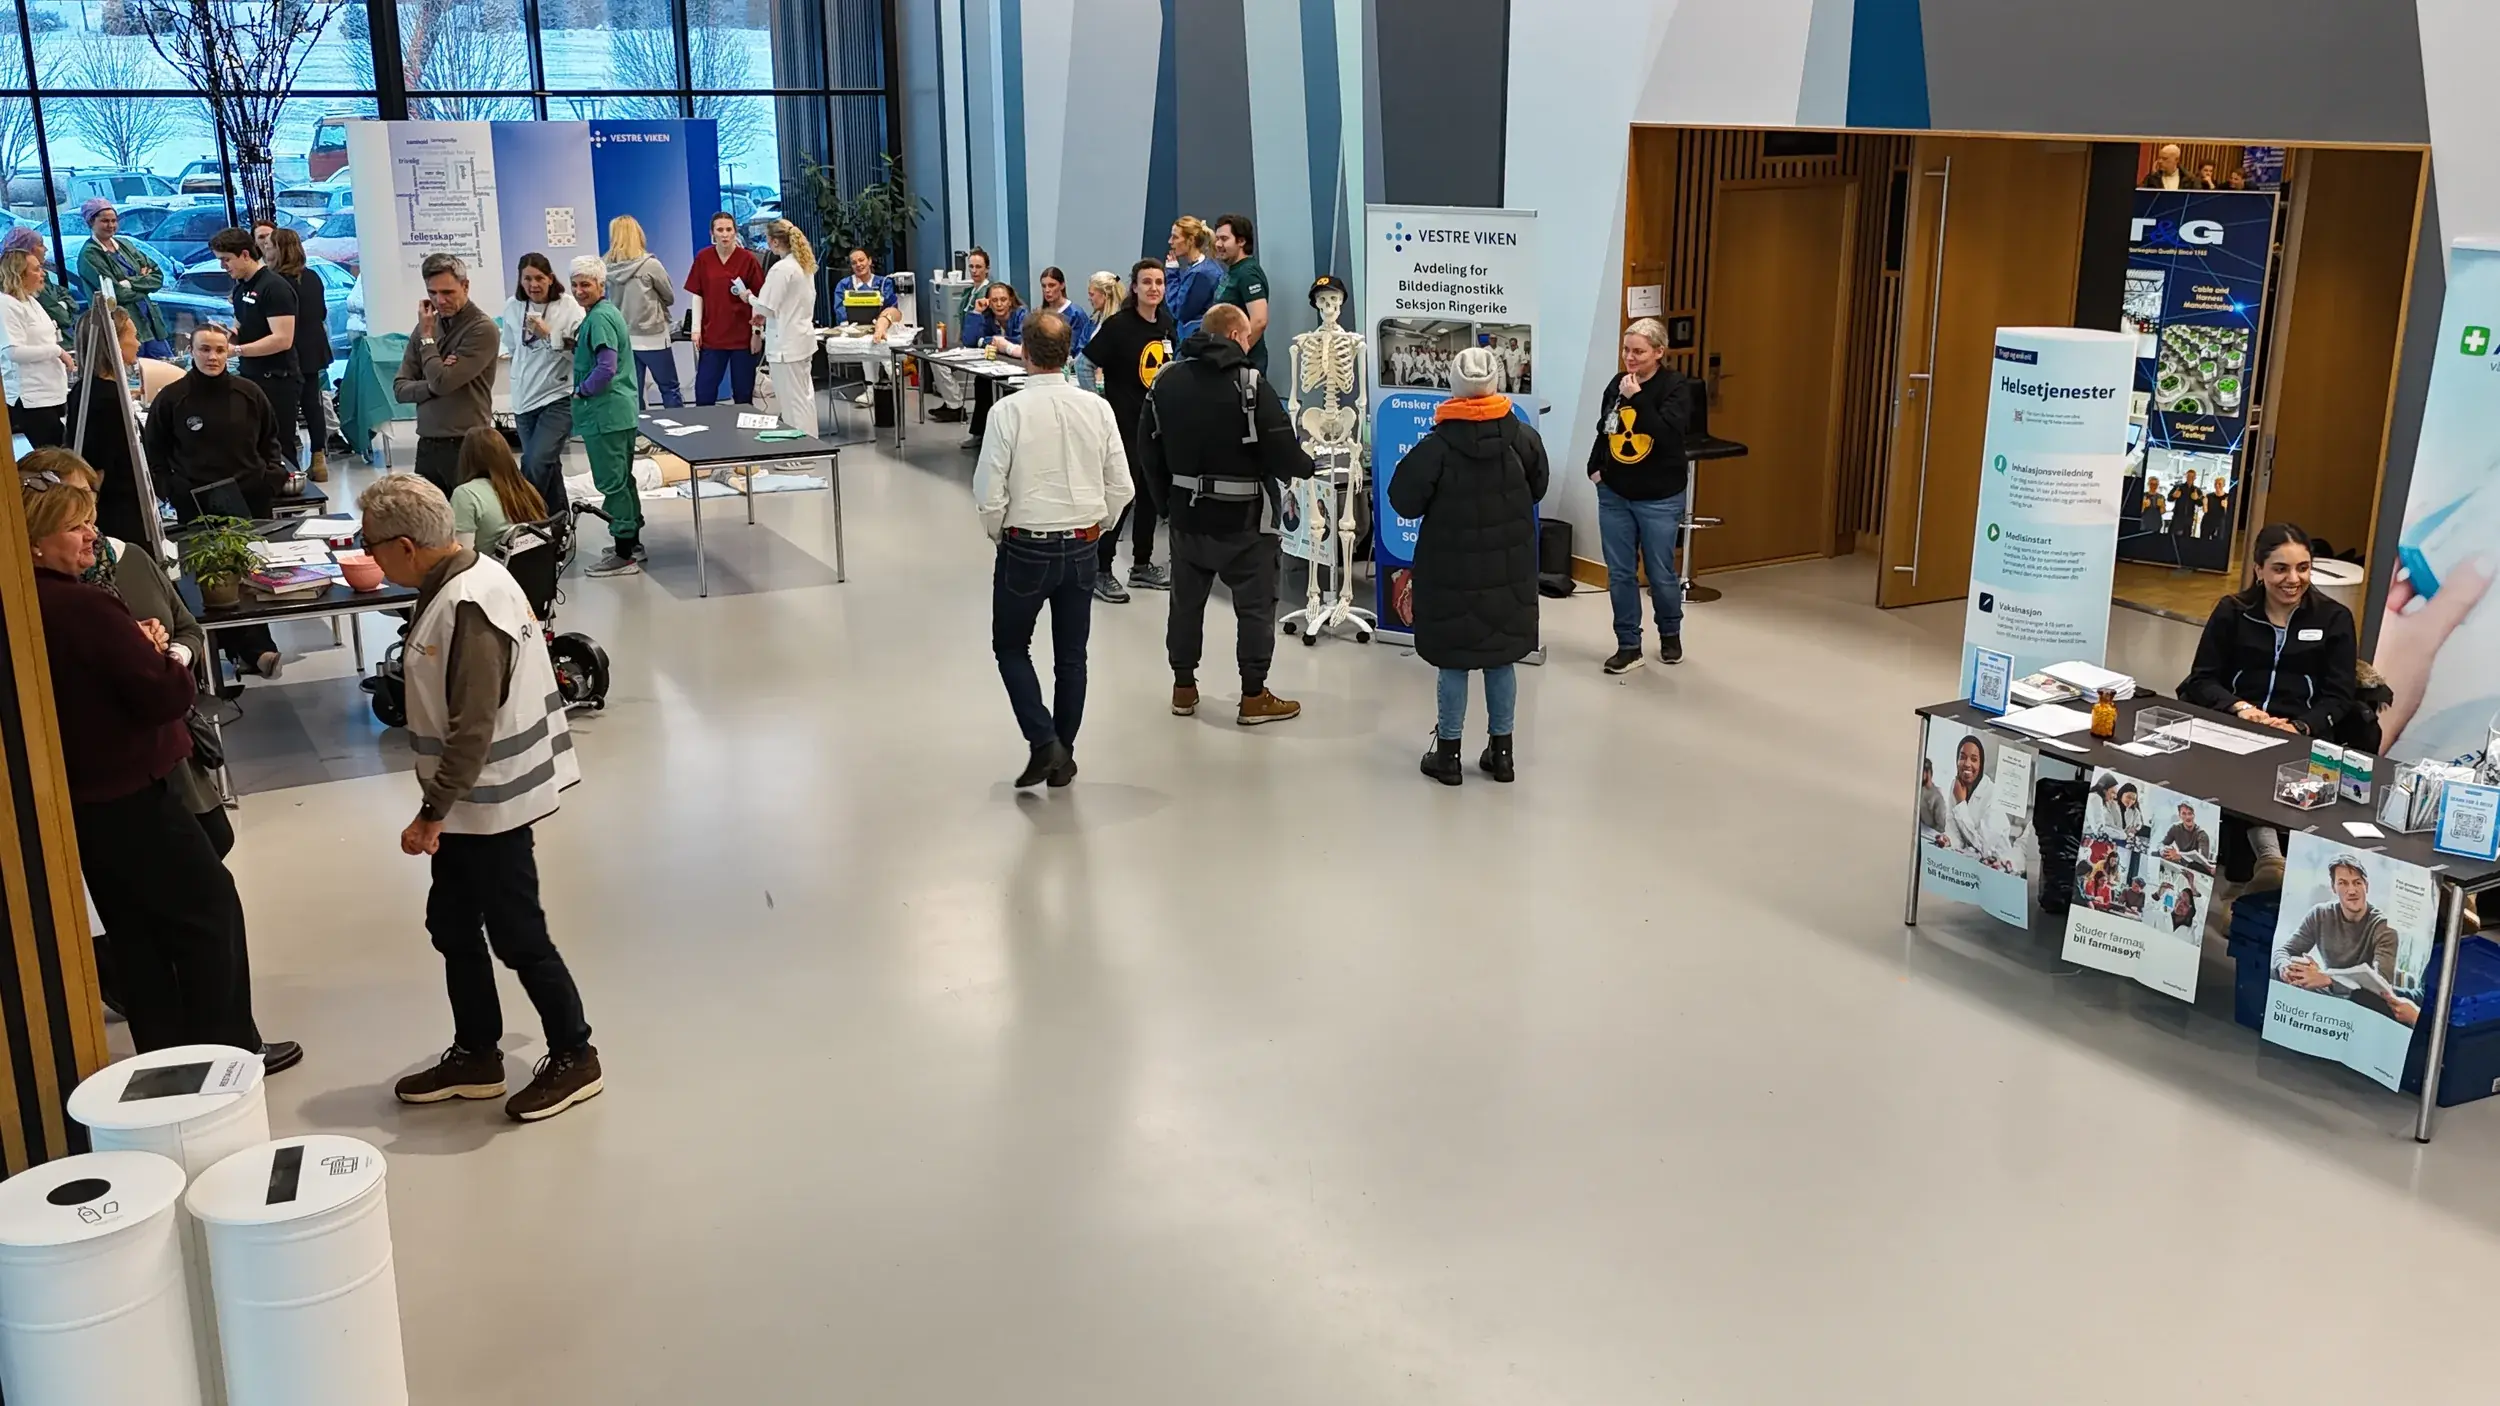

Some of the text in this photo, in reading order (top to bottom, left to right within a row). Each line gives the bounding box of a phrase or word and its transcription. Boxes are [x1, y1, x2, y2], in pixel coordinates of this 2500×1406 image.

[610, 133, 670, 142] VESTRE VIKEN
[410, 232, 454, 242] fellesskap
[1418, 229, 1517, 246] VESTRE VIKEN
[1413, 262, 1488, 278] Avdeling for
[1399, 280, 1504, 296] Bildediagnostikk
[2192, 285, 2229, 294] Cable and
[2196, 294, 2223, 302] Harness
[1396, 298, 1508, 315] Seksjon Ringerike
[2183, 301, 2234, 312] Manufacturing
[2001, 376, 2116, 402] Helsetjenester
[1392, 398, 1430, 410] Ønsker
[1414, 416, 1427, 427] ny
[2175, 422, 2215, 433] Design and
[2181, 430, 2206, 441] Testing
[2012, 463, 2094, 479] Inhalasjonsveiledning
[2005, 531, 2052, 545] Medisinstart
[1999, 601, 2043, 617] Vaksinasjon
[1926, 857, 1950, 872] Studer
[1927, 867, 1936, 877] bli
[2074, 922, 2108, 940] Studer
[2073, 933, 2086, 945] bli
[2274, 1000, 2309, 1019] Studer
[2273, 1011, 2286, 1024] bli
